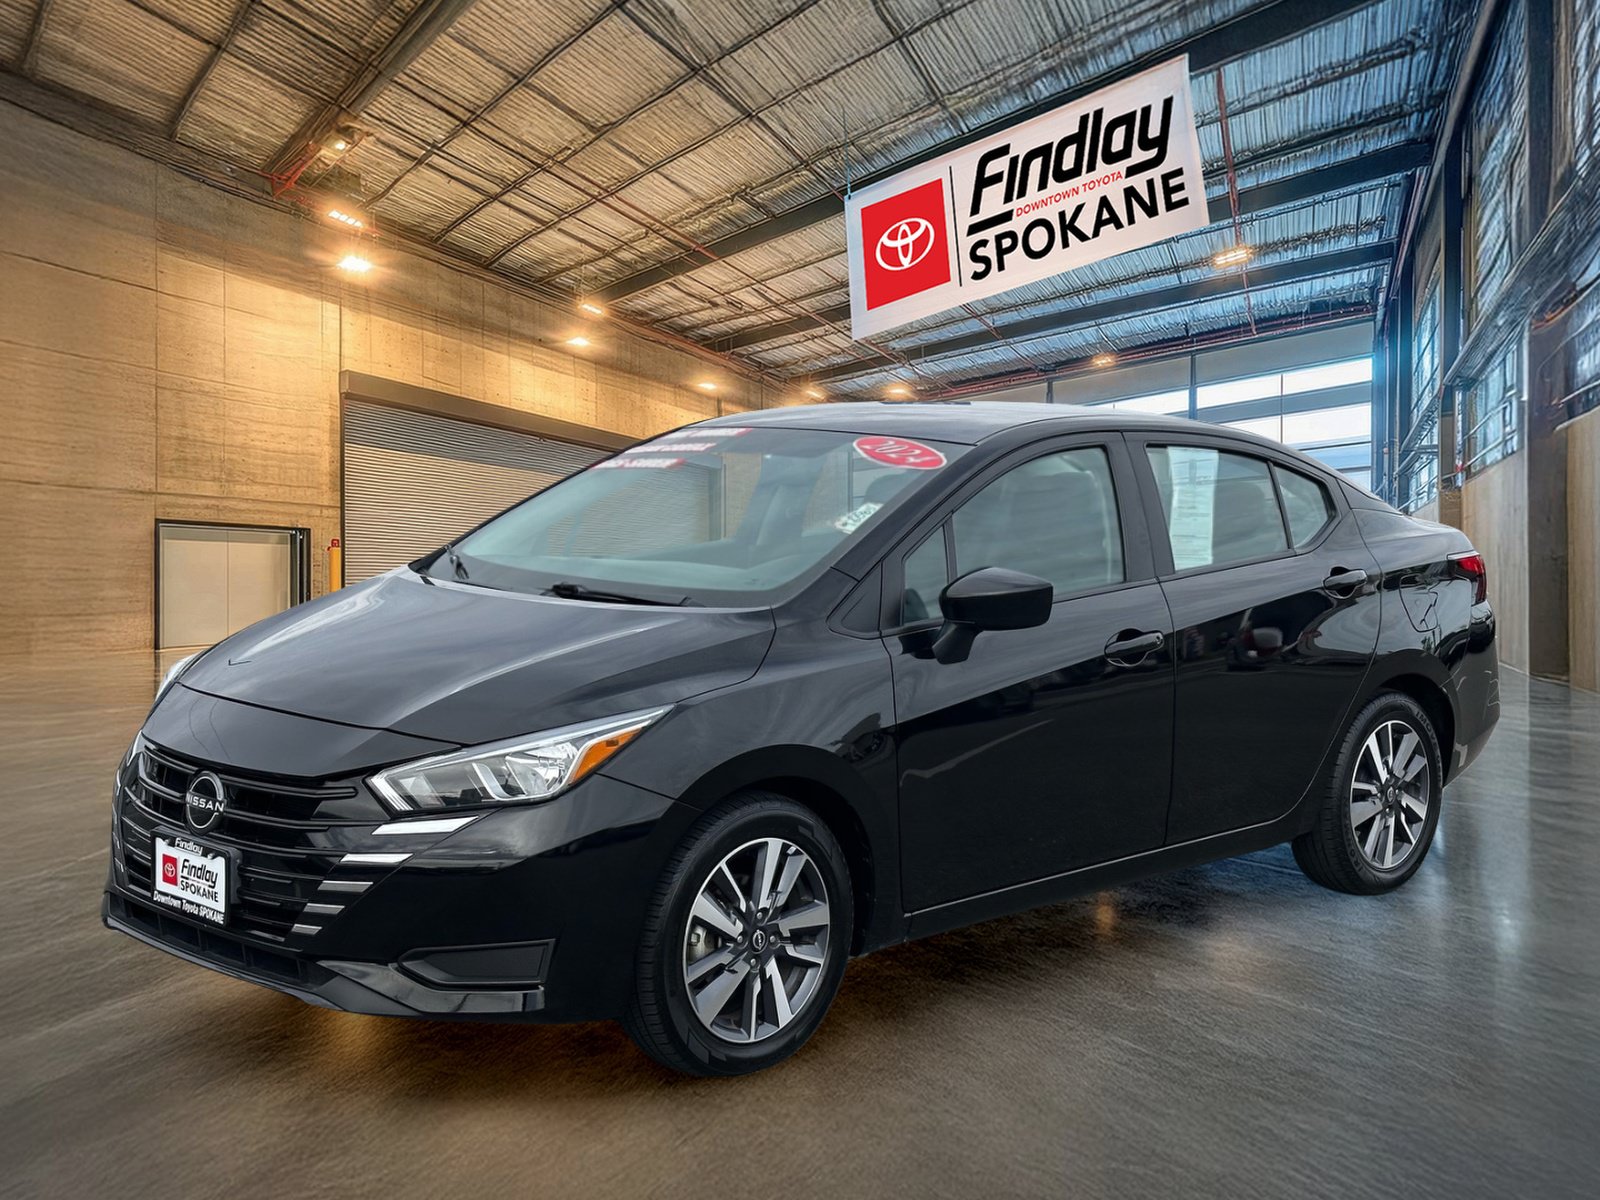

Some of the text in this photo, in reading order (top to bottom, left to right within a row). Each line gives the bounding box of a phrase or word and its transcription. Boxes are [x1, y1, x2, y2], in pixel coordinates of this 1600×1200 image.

[969, 95, 1174, 219] Findlay
[1016, 171, 1123, 218] DOWNTOWN TOYOTA
[970, 167, 1190, 281] SPOKANE
[186, 793, 224, 812] NISSAN
[175, 837, 204, 855] Findlay
[181, 858, 218, 889] Findlay
[153, 890, 225, 925] Downtown Toyota SPOKANE
[180, 879, 219, 903] SPOKANE
